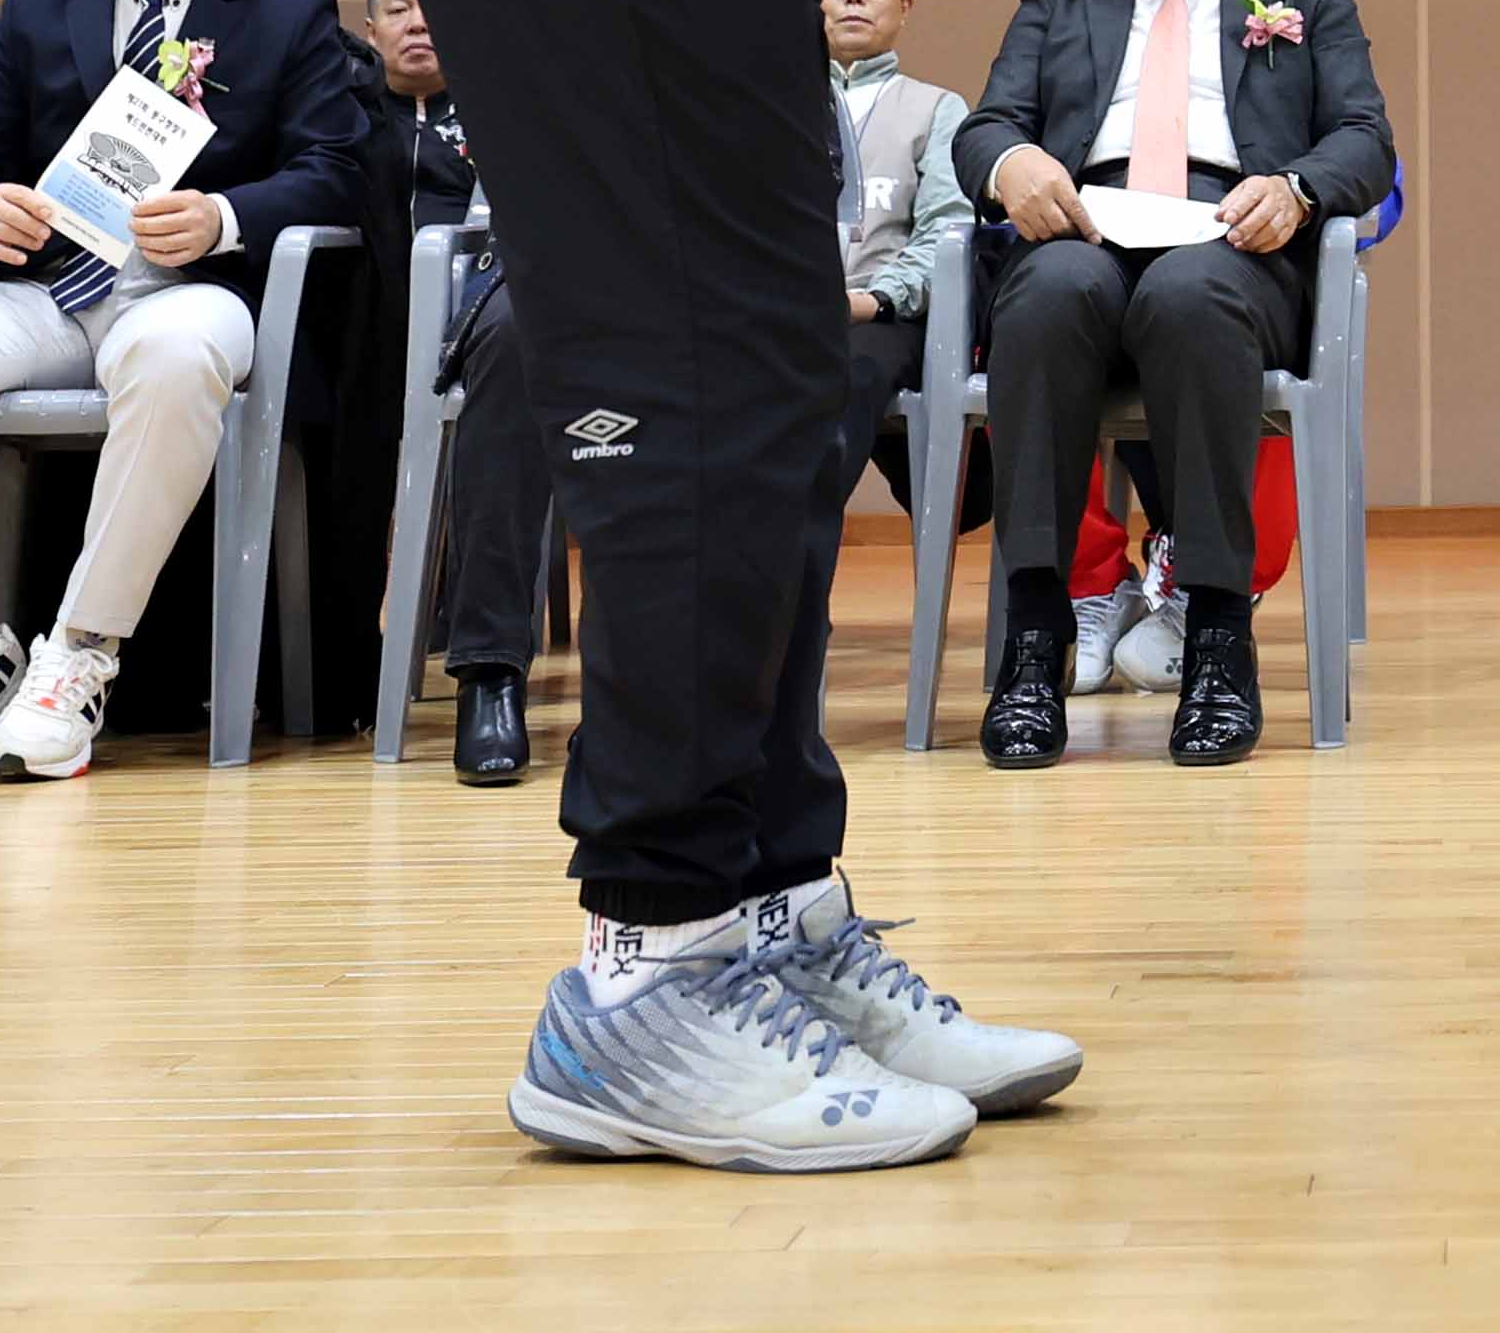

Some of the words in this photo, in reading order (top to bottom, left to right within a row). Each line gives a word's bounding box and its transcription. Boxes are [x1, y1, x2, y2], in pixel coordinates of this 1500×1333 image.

[571, 442, 635, 461] umbro
[756, 891, 791, 953] NEX
[609, 923, 645, 980] NEX
